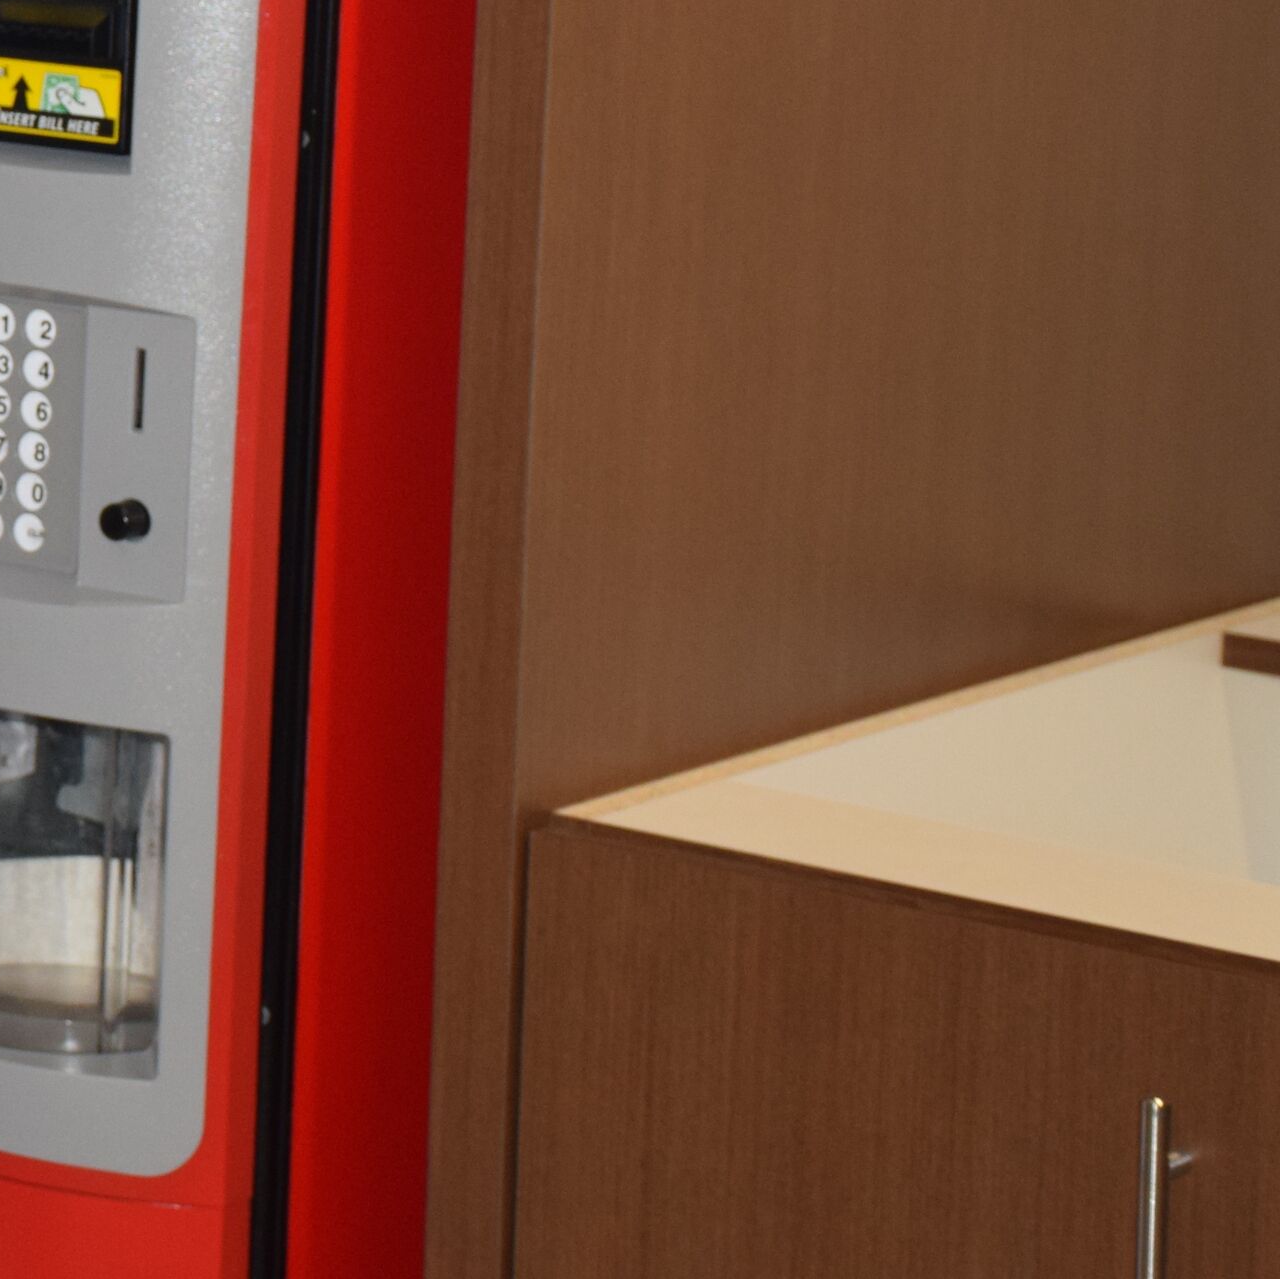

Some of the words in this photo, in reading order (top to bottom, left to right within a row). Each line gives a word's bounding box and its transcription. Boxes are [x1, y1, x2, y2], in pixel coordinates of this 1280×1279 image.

[37, 111, 65, 130] BILL
[67, 116, 101, 136] HERE
[0, 315, 10, 335] 1
[39, 320, 54, 341] 2
[37, 361, 50, 381] 4
[36, 401, 48, 422] 6
[33, 442, 46, 463] 8
[31, 483, 44, 504] 0
